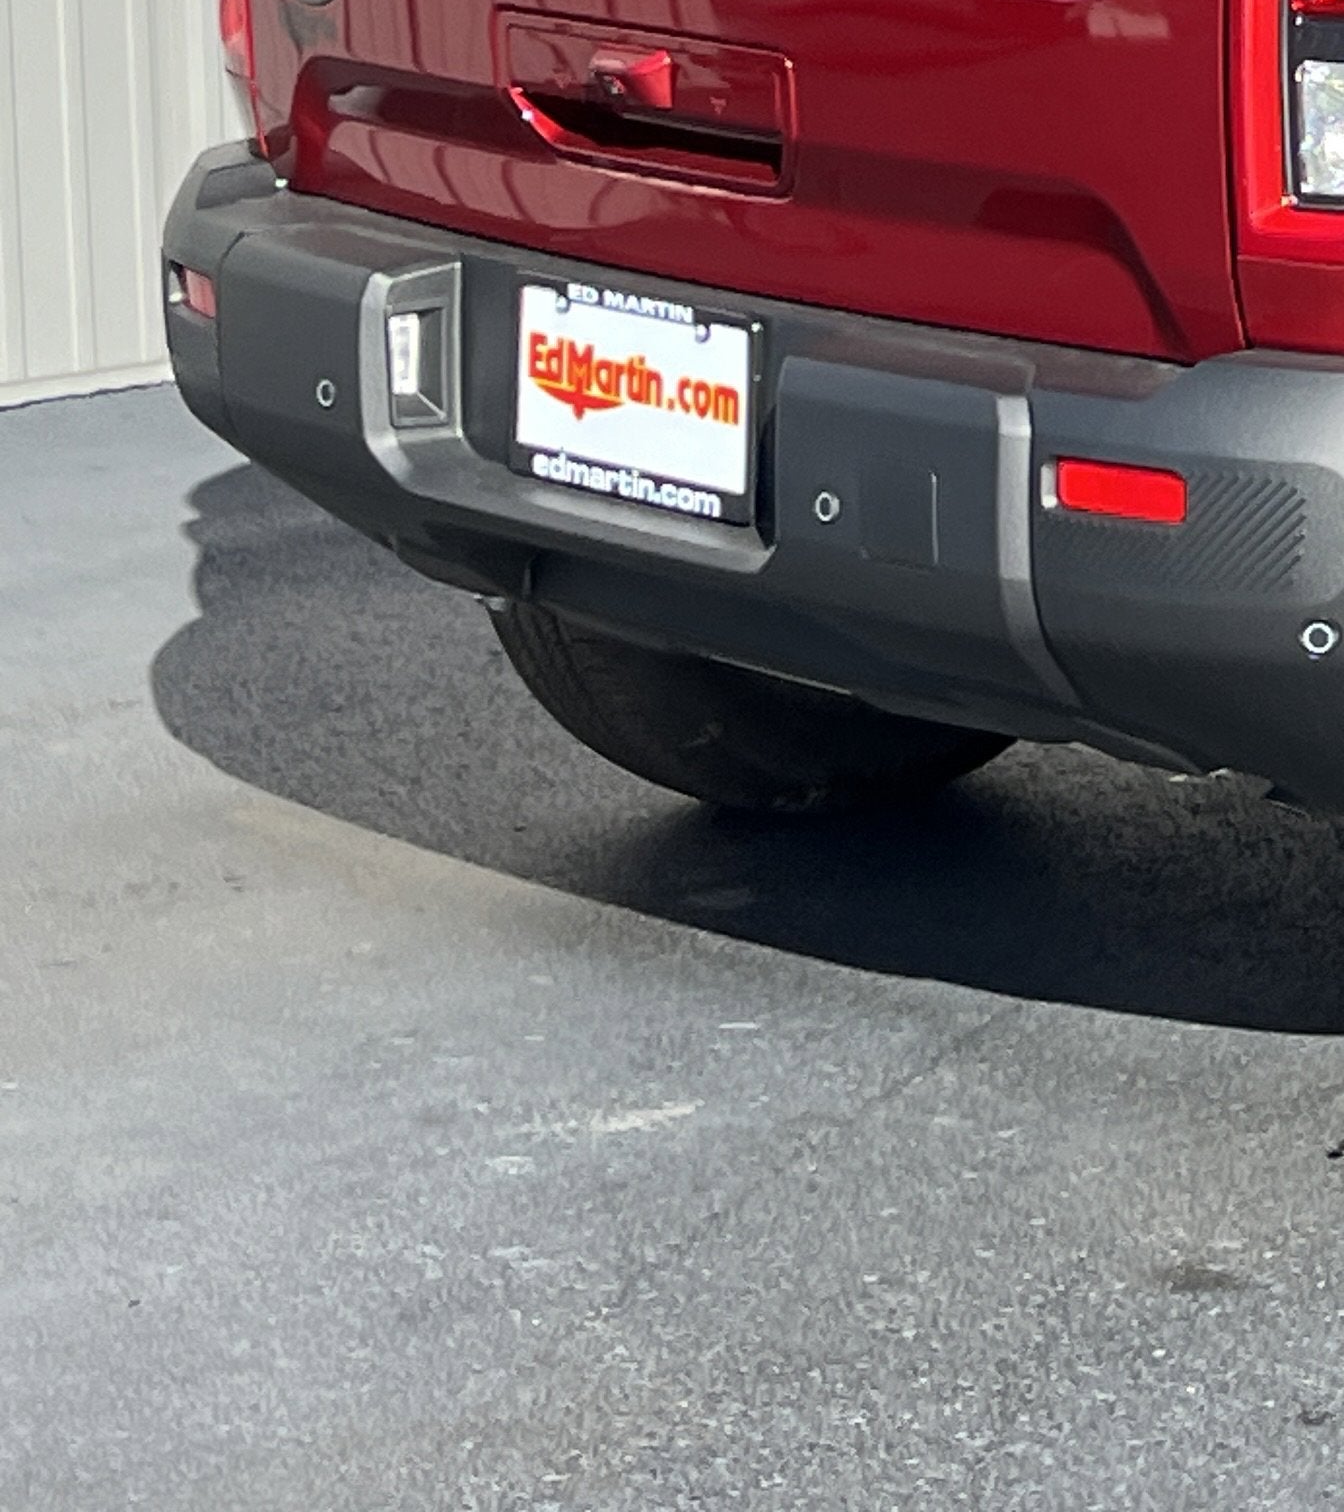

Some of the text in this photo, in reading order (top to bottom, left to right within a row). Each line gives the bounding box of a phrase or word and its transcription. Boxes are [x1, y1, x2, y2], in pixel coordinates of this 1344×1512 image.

[566, 283, 694, 324] ED MARTIN
[531, 452, 722, 518] edmartin.com
